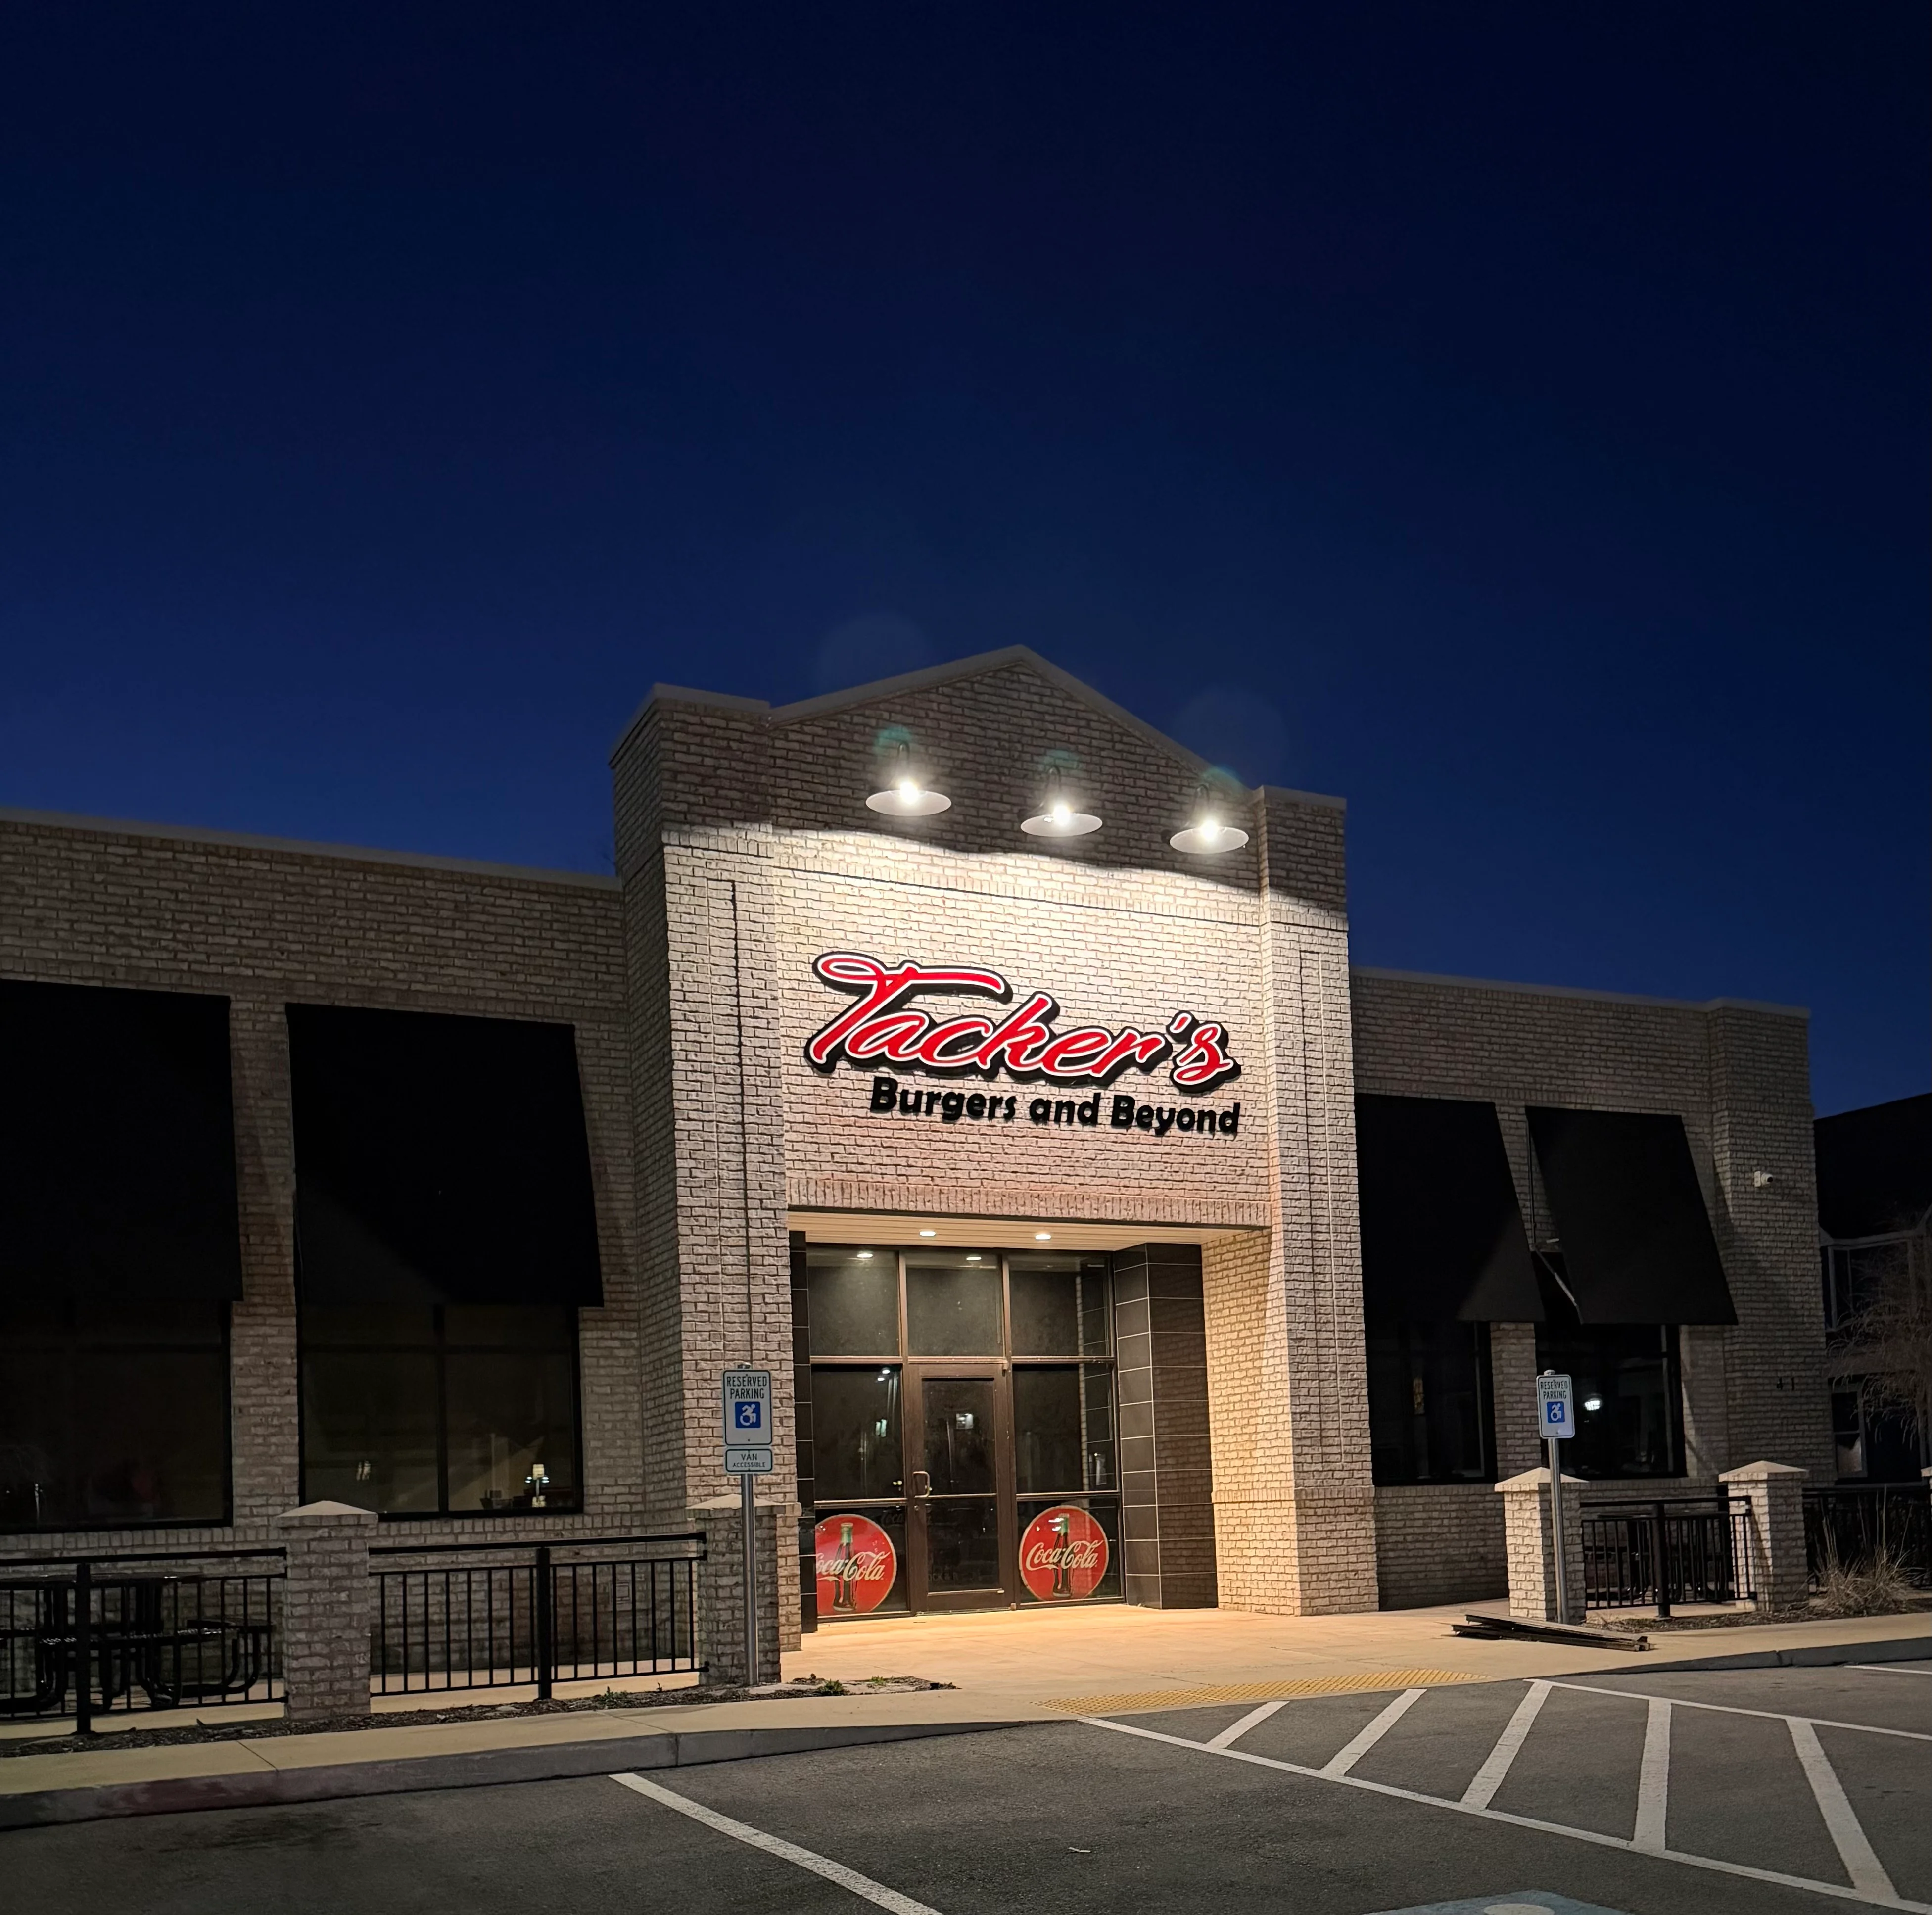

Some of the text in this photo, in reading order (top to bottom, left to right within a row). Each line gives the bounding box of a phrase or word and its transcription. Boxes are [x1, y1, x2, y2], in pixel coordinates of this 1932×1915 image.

[805, 952, 1241, 1092] Tacker's
[870, 1076, 1240, 1135] Burgers and Beyond
[727, 1376, 767, 1387] RESERVED
[1540, 1381, 1568, 1390] RESERVED
[730, 1388, 764, 1399] PARKING
[1543, 1391, 1567, 1400] PARKING
[1026, 1540, 1104, 1571] Coca-Cola
